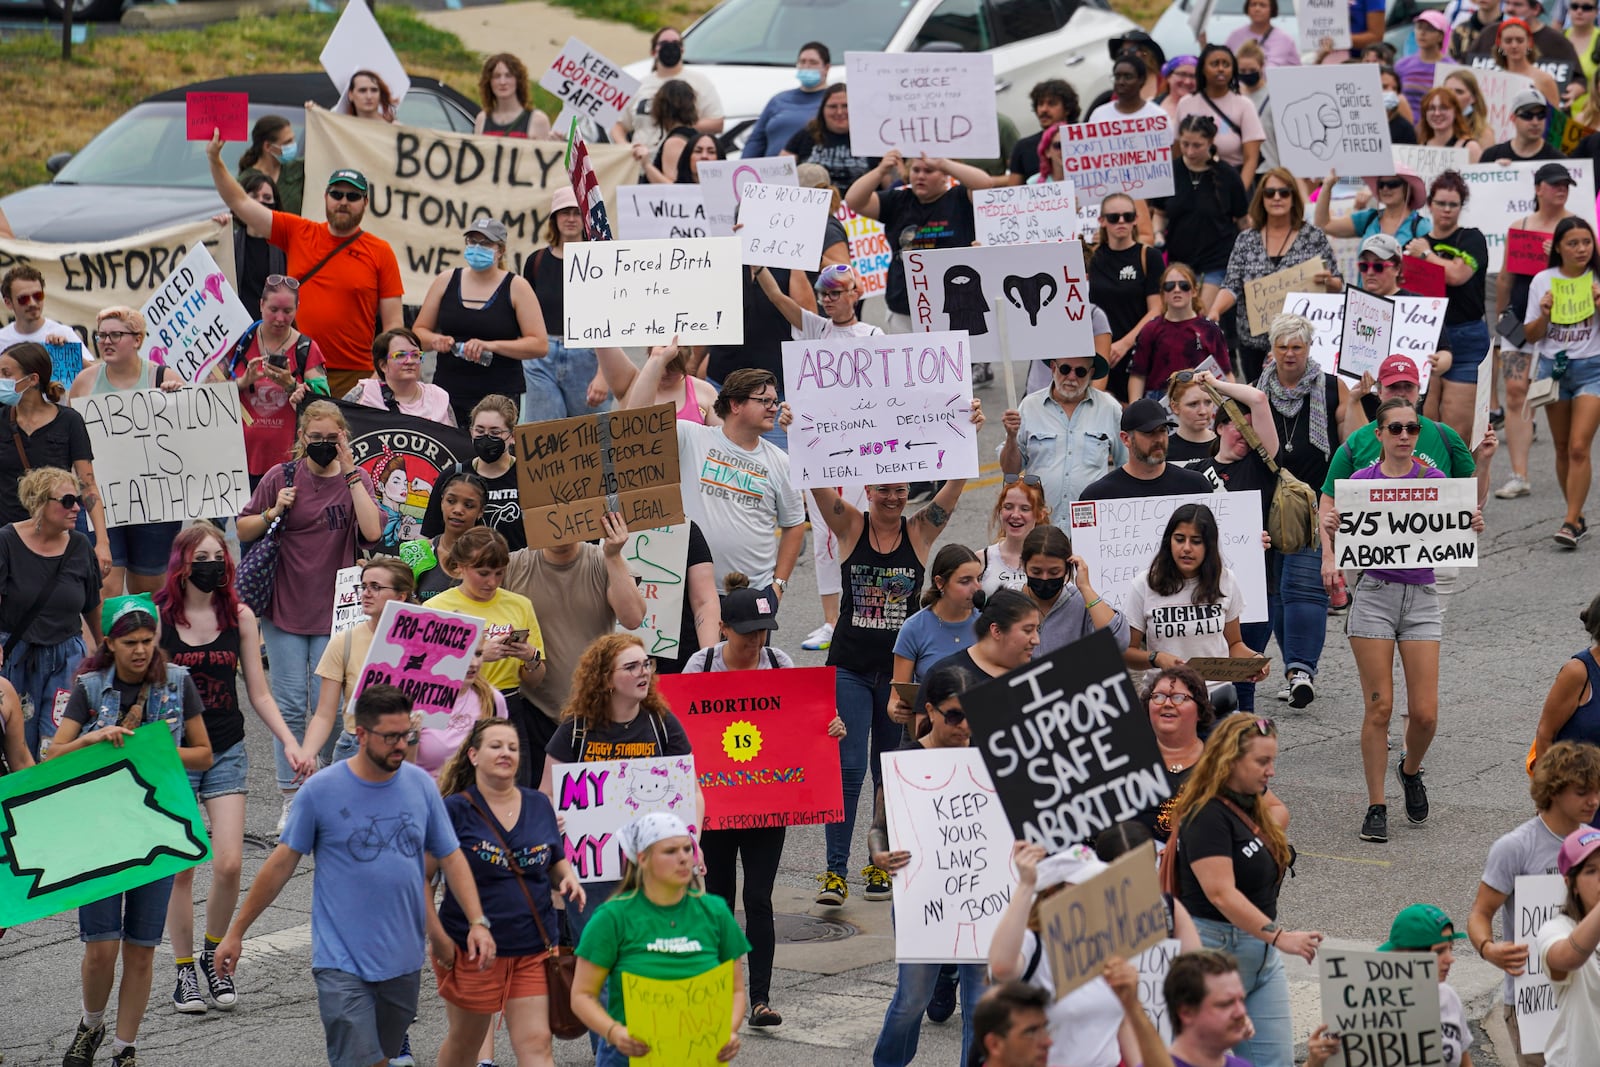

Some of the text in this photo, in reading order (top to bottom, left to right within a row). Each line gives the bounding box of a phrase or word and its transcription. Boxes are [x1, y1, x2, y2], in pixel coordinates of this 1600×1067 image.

[580, 52, 618, 80] KEEP
[551, 55, 630, 111] ABORTION
[900, 76, 951, 88] CHOICE
[558, 80, 603, 117] SAFE
[1340, 95, 1372, 108] CHOICE
[879, 115, 972, 146] CHILD
[1067, 116, 1167, 141] HOOSIERS
[1343, 138, 1382, 152] FIRED!
[396, 132, 563, 188] BODILY
[1065, 147, 1169, 172] GOVERNMENT
[984, 188, 1014, 204] STOP
[1081, 180, 1143, 198] TO DO
[649, 201, 684, 218] WILL
[1026, 215, 1039, 227] US
[856, 234, 889, 257] POOR
[569, 248, 711, 283] No Forced Birth
[859, 255, 889, 275] BLAC
[147, 266, 195, 327] ORCED
[613, 281, 671, 300] in the
[1063, 265, 1085, 322] LAW
[1252, 269, 1304, 299] Protect
[158, 294, 206, 348] BIRTH
[1401, 303, 1437, 328] You
[568, 317, 612, 341] Land
[621, 322, 636, 337] of
[645, 318, 665, 335] the
[1356, 317, 1377, 345] Crappy
[176, 314, 230, 382] CRIME
[1396, 335, 1434, 352] can
[797, 341, 963, 390] ABORTION
[85, 383, 238, 438] ABORTION
[851, 397, 906, 411] is a
[816, 410, 955, 434] PERSONAL DECISION
[378, 433, 441, 463] YOUR
[521, 409, 673, 462] LEAVE THE CHOICE
[859, 438, 899, 457] NOT
[134, 433, 184, 479] IS
[527, 439, 663, 483] WITH THE PEOPLE
[708, 448, 769, 477] STRONGER
[549, 463, 665, 507] KEEP ABORTION
[803, 467, 810, 481] A
[823, 465, 863, 479] LEGAL
[700, 482, 761, 509] TOGETHER
[547, 499, 671, 541] SAFE LEGAL
[1340, 511, 1473, 537] 5/5 WOULD
[1100, 523, 1142, 543] LIFE
[1100, 543, 1160, 559] PREGNAN
[1339, 543, 1474, 568] ABORT AGAIN
[851, 564, 916, 579] NOT FRAGILE
[851, 575, 884, 586] LIKE A
[1101, 566, 1138, 591] KEEP
[853, 595, 885, 606] FRAGILE
[854, 605, 882, 618] LIKE A
[852, 616, 887, 629] BOMB
[1155, 605, 1221, 624] RIGHTS
[391, 614, 471, 651] PRO-CHOICE
[1155, 618, 1222, 639] FOR ALL
[172, 650, 237, 672] DROP DEAD
[1008, 661, 1064, 714] I
[688, 696, 781, 715] ABORTION
[988, 672, 1130, 778] SUPPORT
[586, 741, 656, 756] ZIGGY STARDUST
[735, 735, 751, 749] IS
[698, 767, 804, 787] HEALTHCARE
[1027, 726, 1130, 809] SAFE
[559, 768, 610, 811] MY
[933, 793, 988, 820] KEEP
[1022, 763, 1171, 855] ABORTION
[719, 810, 790, 829] REPRODUCTIVE
[939, 822, 987, 846] YOUR
[519, 852, 547, 868] Body
[562, 832, 612, 878] MY
[936, 848, 987, 871] LAWS
[946, 874, 980, 895] OFF
[924, 898, 944, 927] MY
[1325, 957, 1434, 983] I DON'T
[1343, 985, 1415, 1010] CARE
[1517, 984, 1557, 1017] ABORTI
[1336, 1009, 1407, 1032] WHAT
[1340, 1030, 1441, 1067] BIBLE
